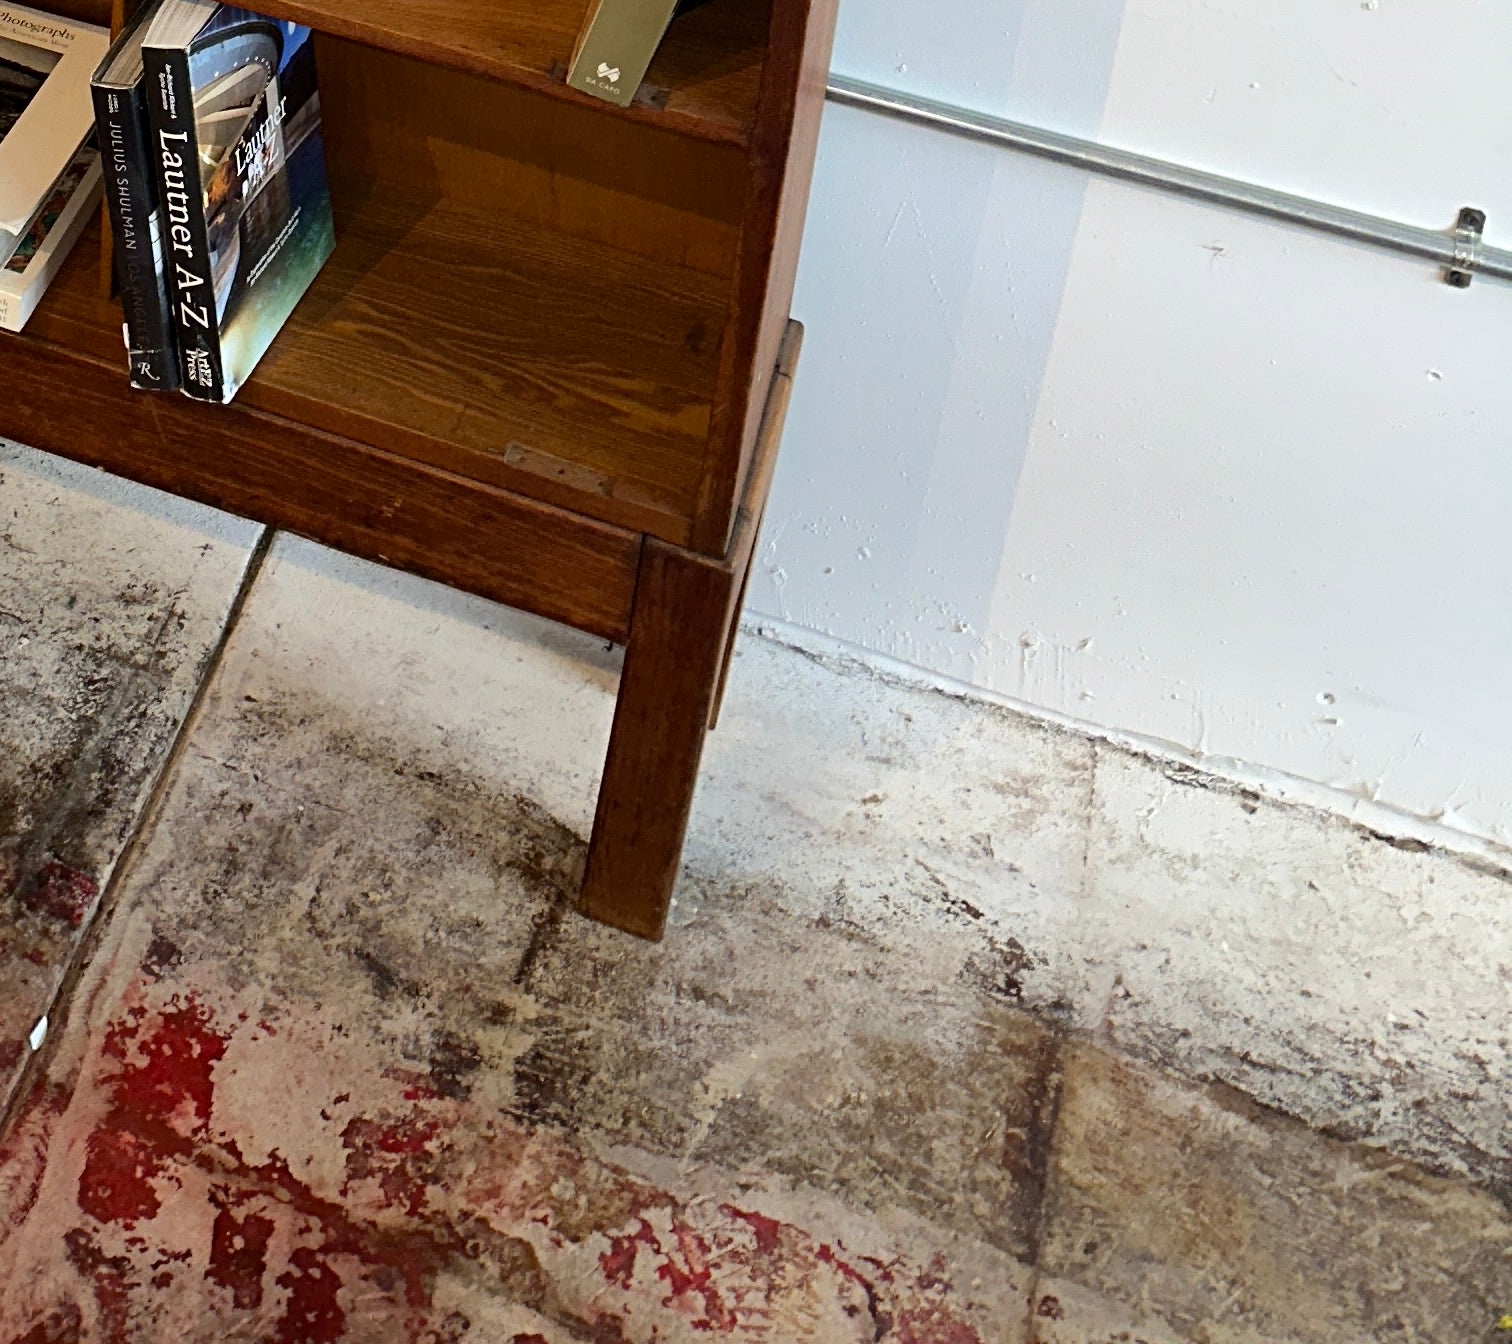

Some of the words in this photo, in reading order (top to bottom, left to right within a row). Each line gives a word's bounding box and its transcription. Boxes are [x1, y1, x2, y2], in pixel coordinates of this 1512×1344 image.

[109, 121, 127, 172] JULIUS
[234, 96, 287, 177] Lautner
[116, 178, 137, 250] SHULMAN
[159, 129, 194, 260] Lautner
[175, 263, 210, 329] A-Z
